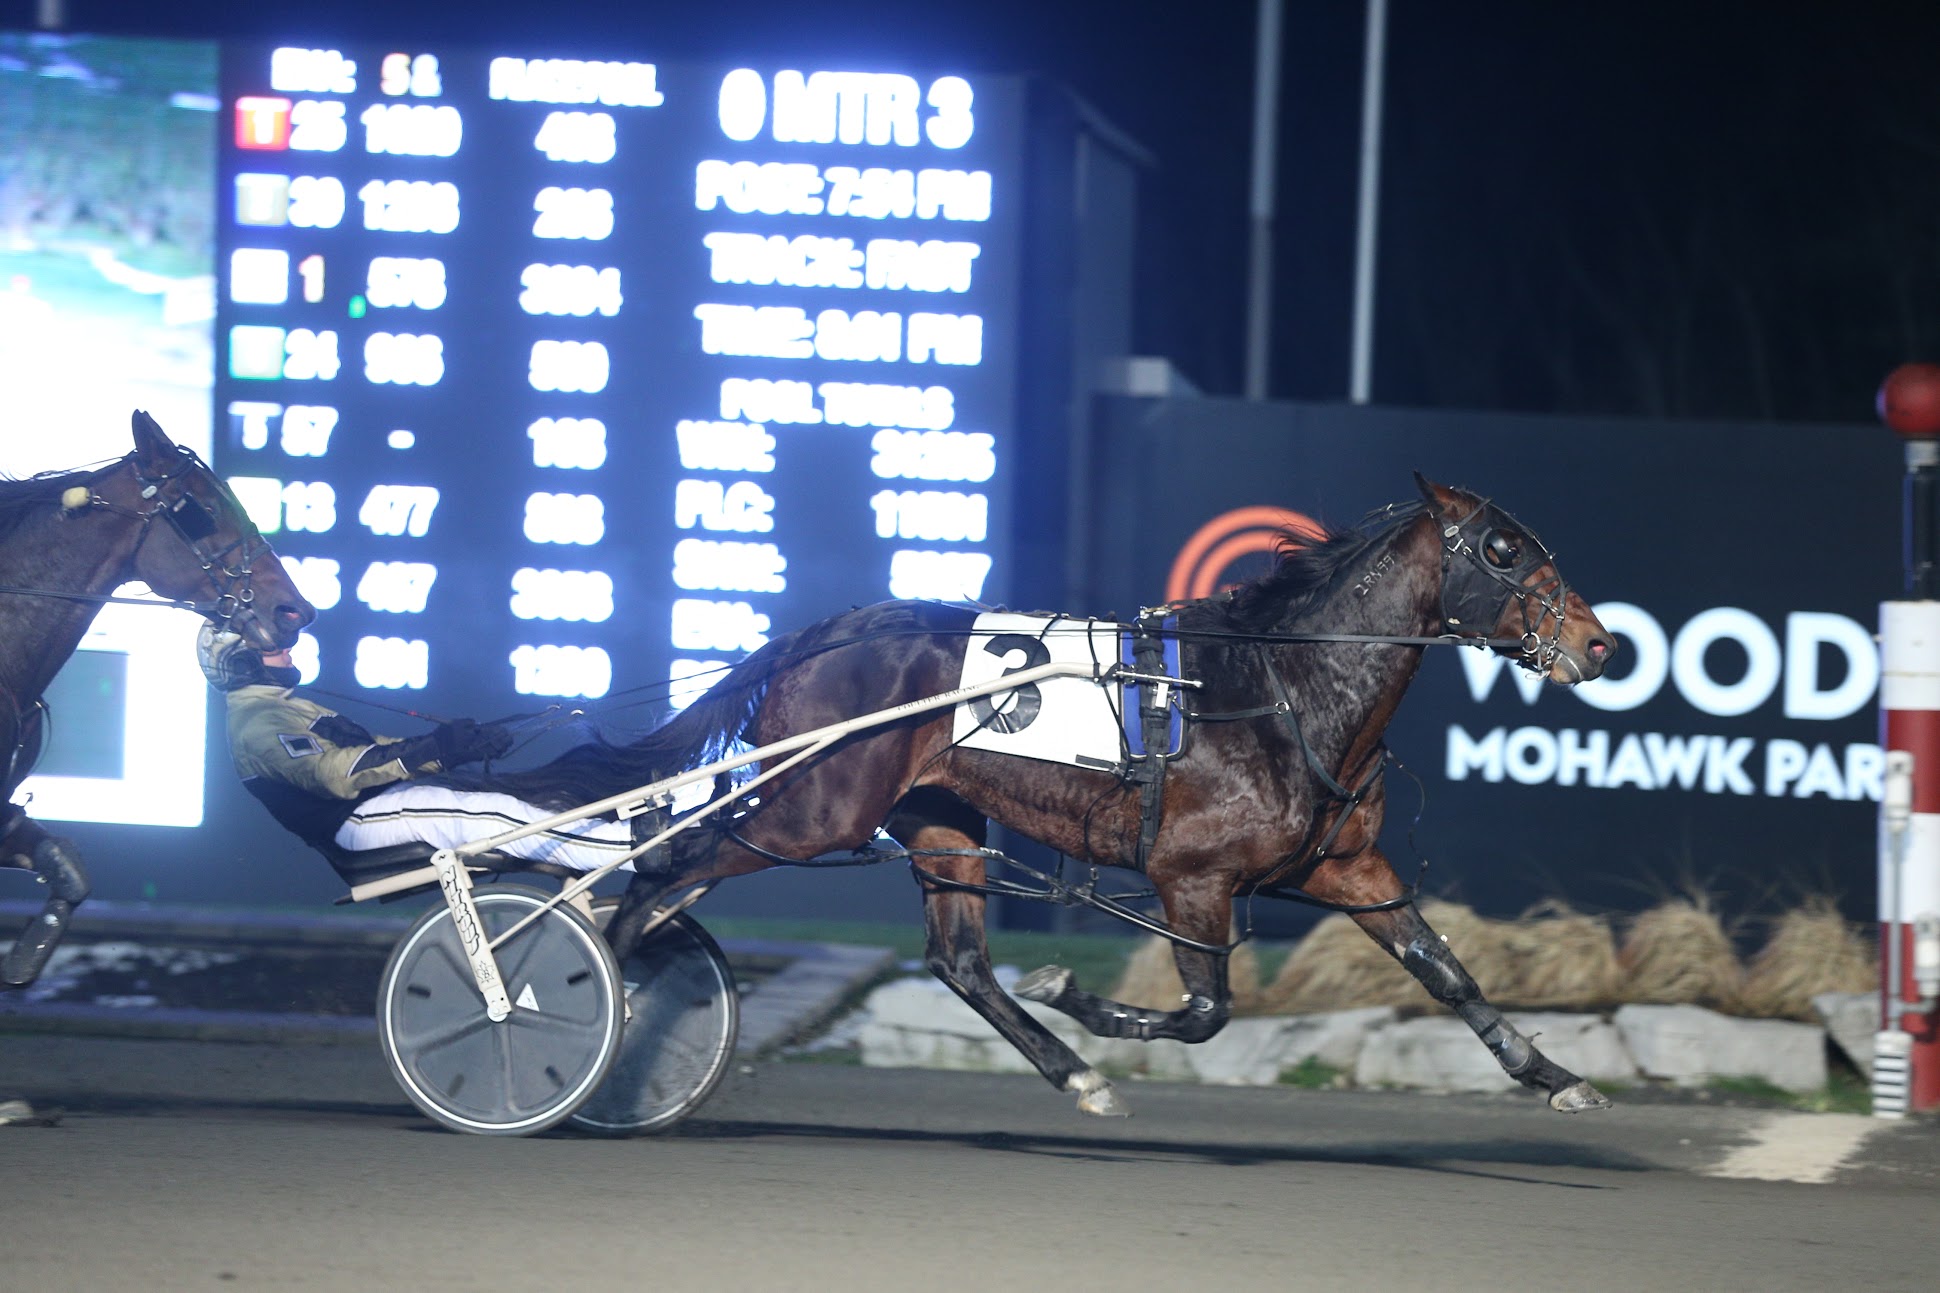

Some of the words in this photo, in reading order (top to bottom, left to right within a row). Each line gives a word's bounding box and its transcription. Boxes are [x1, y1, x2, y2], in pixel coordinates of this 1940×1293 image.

[925, 75, 975, 150] 3
[916, 168, 993, 222] PM
[907, 312, 984, 366] PM
[968, 633, 1051, 735] 3
[1446, 724, 1756, 796] MOHAWK
